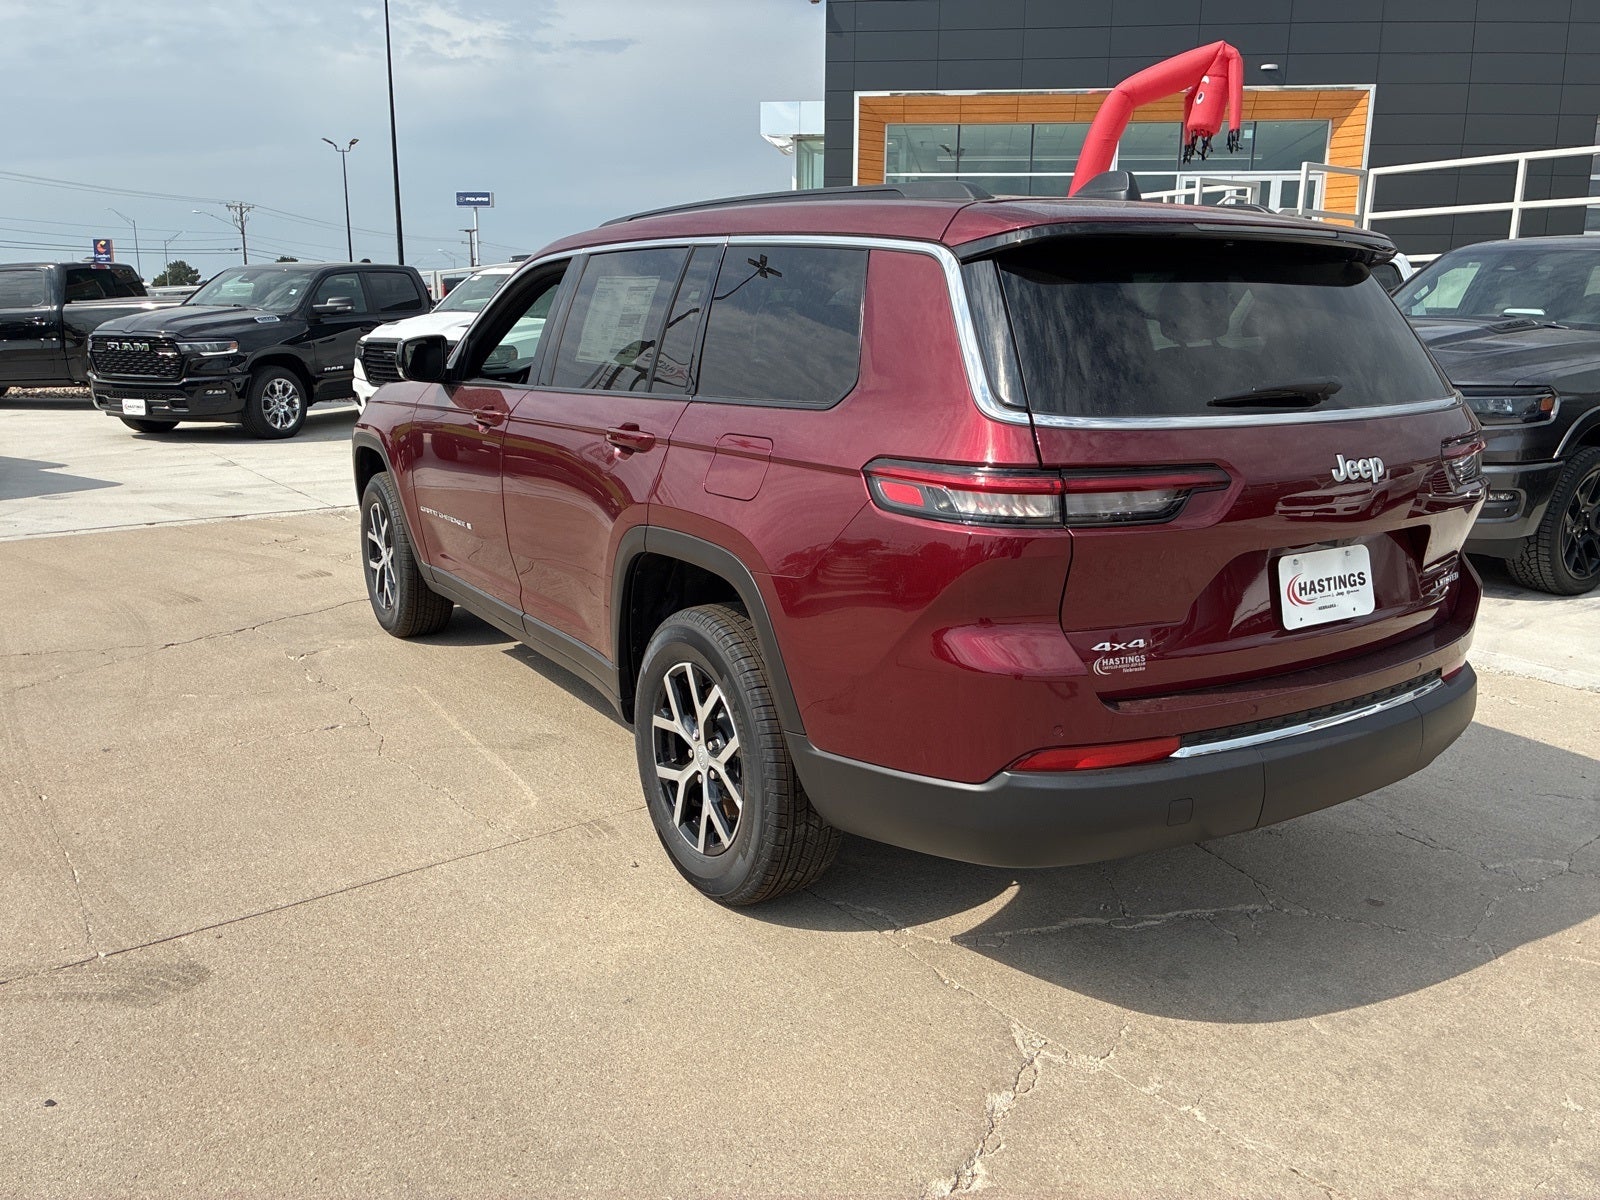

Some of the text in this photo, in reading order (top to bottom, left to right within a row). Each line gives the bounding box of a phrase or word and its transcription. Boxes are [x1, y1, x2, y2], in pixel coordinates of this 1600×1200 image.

[106, 341, 150, 352] RAM
[1331, 454, 1385, 484] Jeep
[1298, 571, 1366, 597] HASTINGS
[1091, 638, 1147, 651] 4x4
[1102, 654, 1146, 667] HASTINGS
